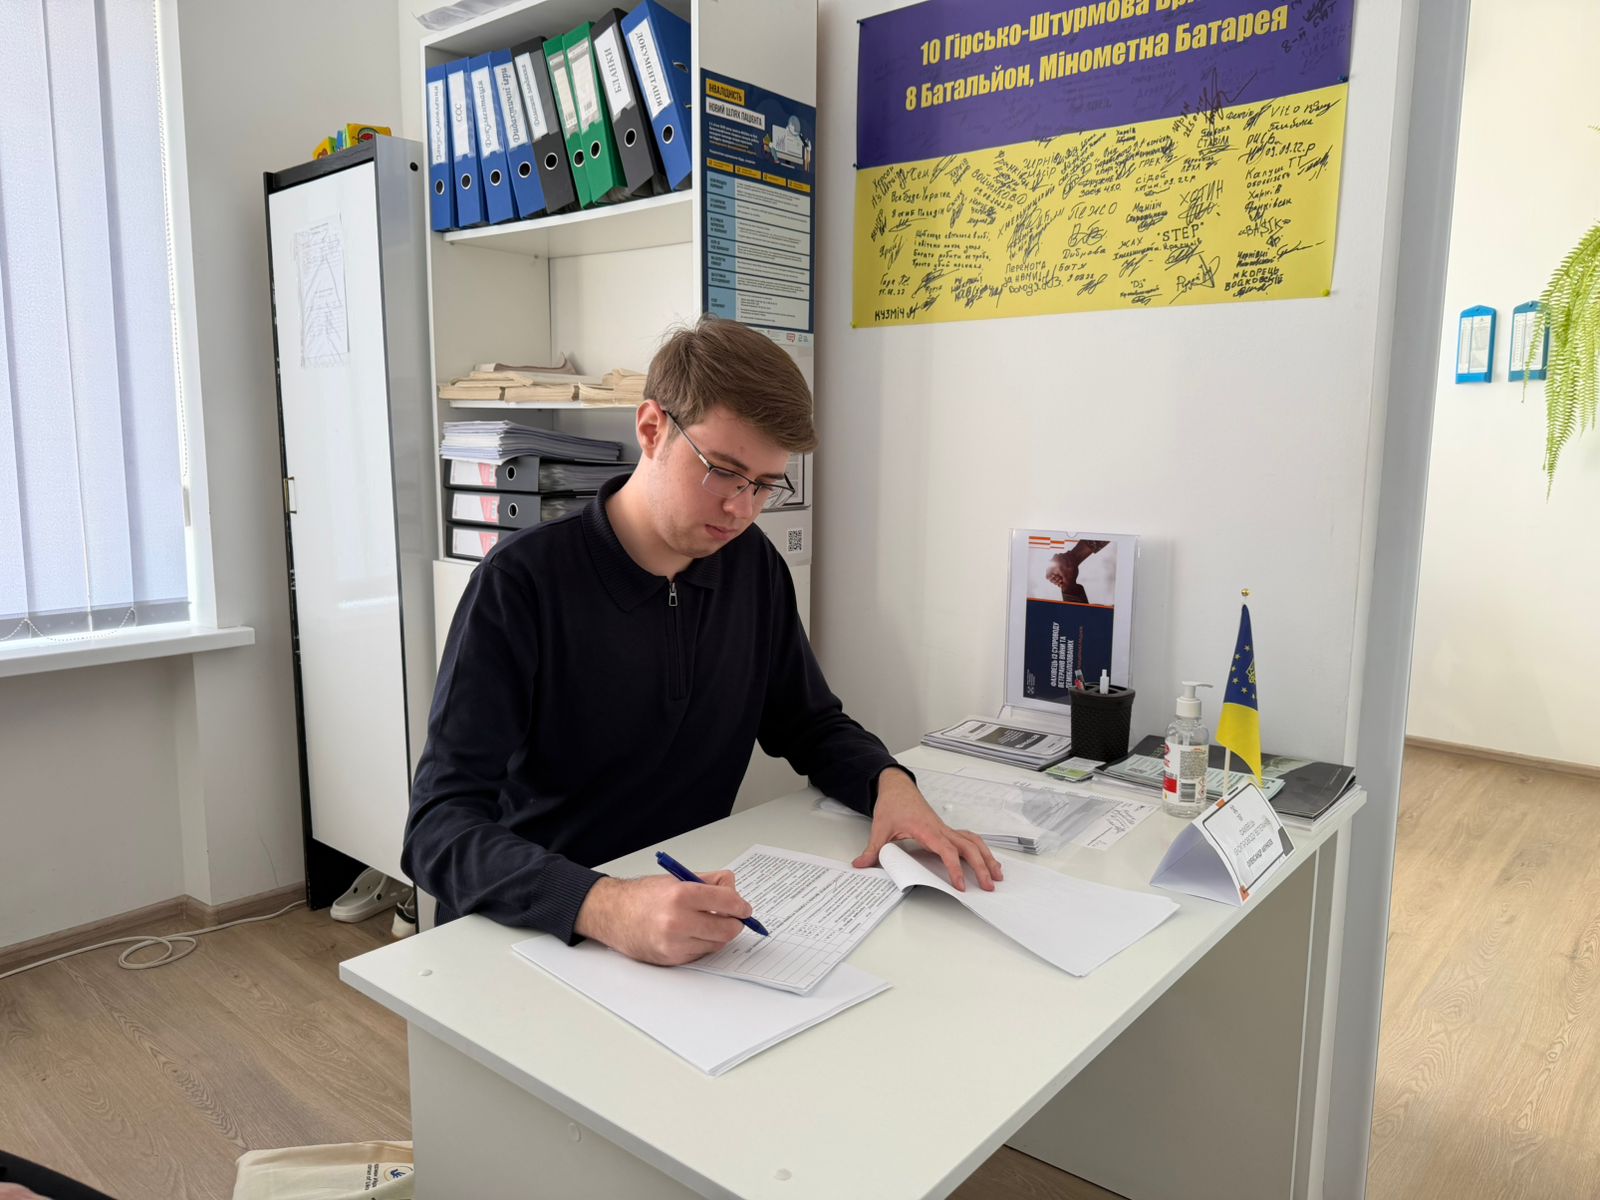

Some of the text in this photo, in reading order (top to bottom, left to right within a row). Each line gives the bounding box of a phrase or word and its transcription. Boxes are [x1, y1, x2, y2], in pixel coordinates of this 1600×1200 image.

[905, 86, 917, 111] 8
[920, 64, 1034, 108] Батальйон,
[1039, 32, 1169, 83] Мінометна
[1175, 5, 1289, 52] Батарея
[920, 0, 1149, 66] 10 Гірсько-Штурмова
[604, 47, 621, 94] БЛАНКИ
[636, 31, 663, 107] ДОКУМЕНТАЦІЯ
